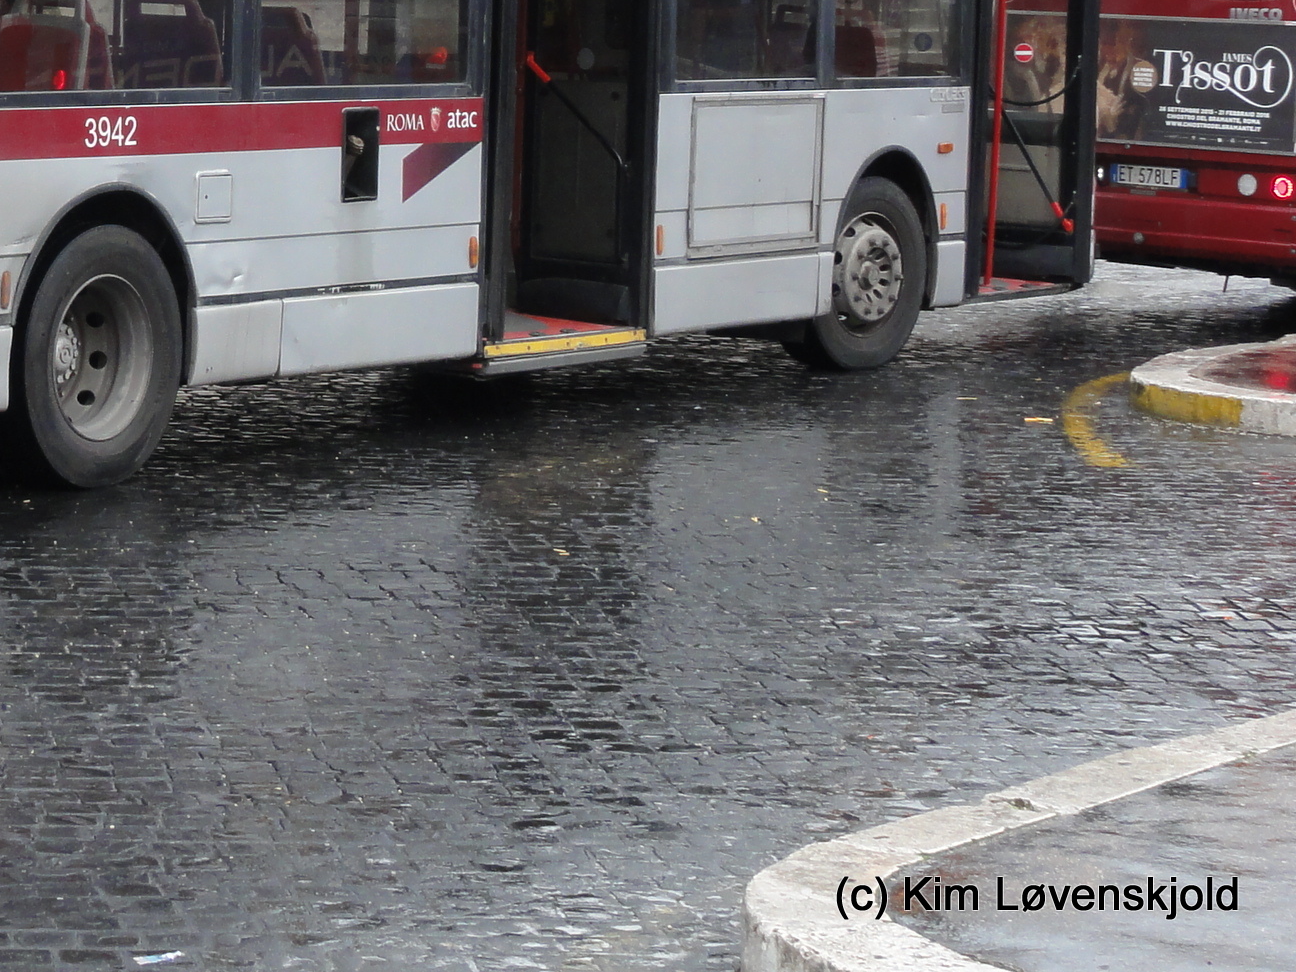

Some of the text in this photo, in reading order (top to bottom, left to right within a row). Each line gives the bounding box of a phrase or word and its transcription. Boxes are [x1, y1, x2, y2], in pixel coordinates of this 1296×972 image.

[1229, 7, 1283, 21] IVECO
[1222, 52, 1253, 63] JAMES
[386, 108, 478, 131] ROMA atac
[84, 116, 137, 148] 3942
[1119, 165, 1179, 185] ET 578LF
